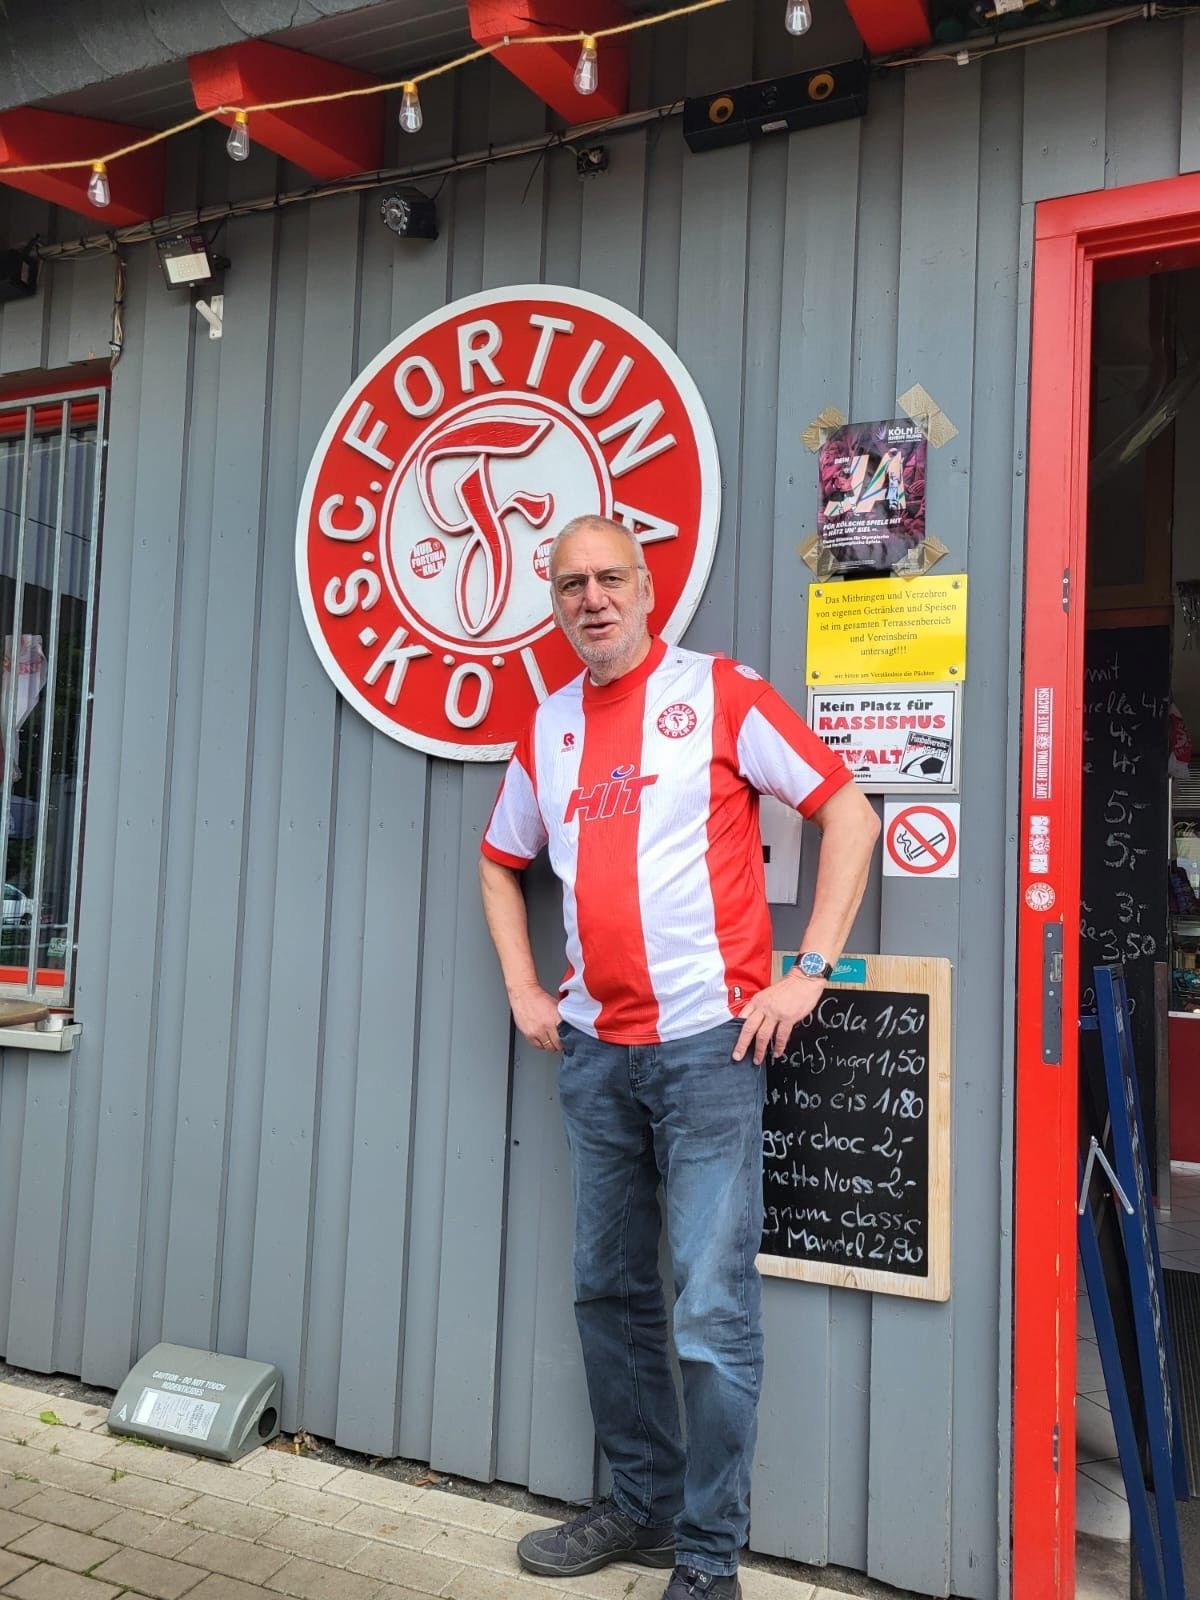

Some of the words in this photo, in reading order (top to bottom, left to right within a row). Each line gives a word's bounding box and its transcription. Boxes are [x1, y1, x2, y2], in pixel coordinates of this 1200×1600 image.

[826, 596, 840, 604] Das
[842, 592, 885, 603] Mitbringen
[888, 591, 902, 600] und
[906, 590, 947, 599] Verzehren
[832, 608, 861, 618] eigenen
[864, 606, 904, 615] Getränken
[907, 604, 922, 612] und
[925, 604, 956, 613] Speisen
[831, 623, 841, 631] im
[844, 620, 880, 631] gesamten
[883, 617, 951, 628] Terrassenbereich
[850, 634, 864, 643] und
[868, 632, 917, 642] Vereinsheim
[860, 646, 907, 656] untersagt!!!
[364, 625, 549, 729] KÖL
[820, 702, 854, 712] Kein
[861, 700, 901, 711] Platz
[907, 699, 933, 711] für
[1038, 688, 1050, 716] RACISM
[819, 715, 946, 730] RASSISMUS
[1038, 716, 1049, 733] HATE
[836, 749, 902, 765] EWALT
[1036, 750, 1048, 782] FORTUNA
[1036, 783, 1048, 799] LOVE
[1100, 928, 1156, 965] 3,50
[818, 996, 868, 1032] Cola
[875, 1005, 925, 1039] 1,50
[876, 1050, 925, 1078] 1,50
[830, 1084, 868, 1112] eis
[873, 1088, 924, 1118] 1,80
[762, 1129, 806, 1160] gger
[811, 1121, 864, 1154] choc
[872, 1126, 915, 1163] 2,-
[824, 1167, 874, 1195] Nuss
[787, 1226, 865, 1258] Mandel
[868, 1234, 924, 1264] 2,90
[152, 1370, 180, 1382] CAUTION
[182, 1376, 192, 1384] DO
[191, 1378, 206, 1387] NOT
[205, 1380, 227, 1392] TOUCH
